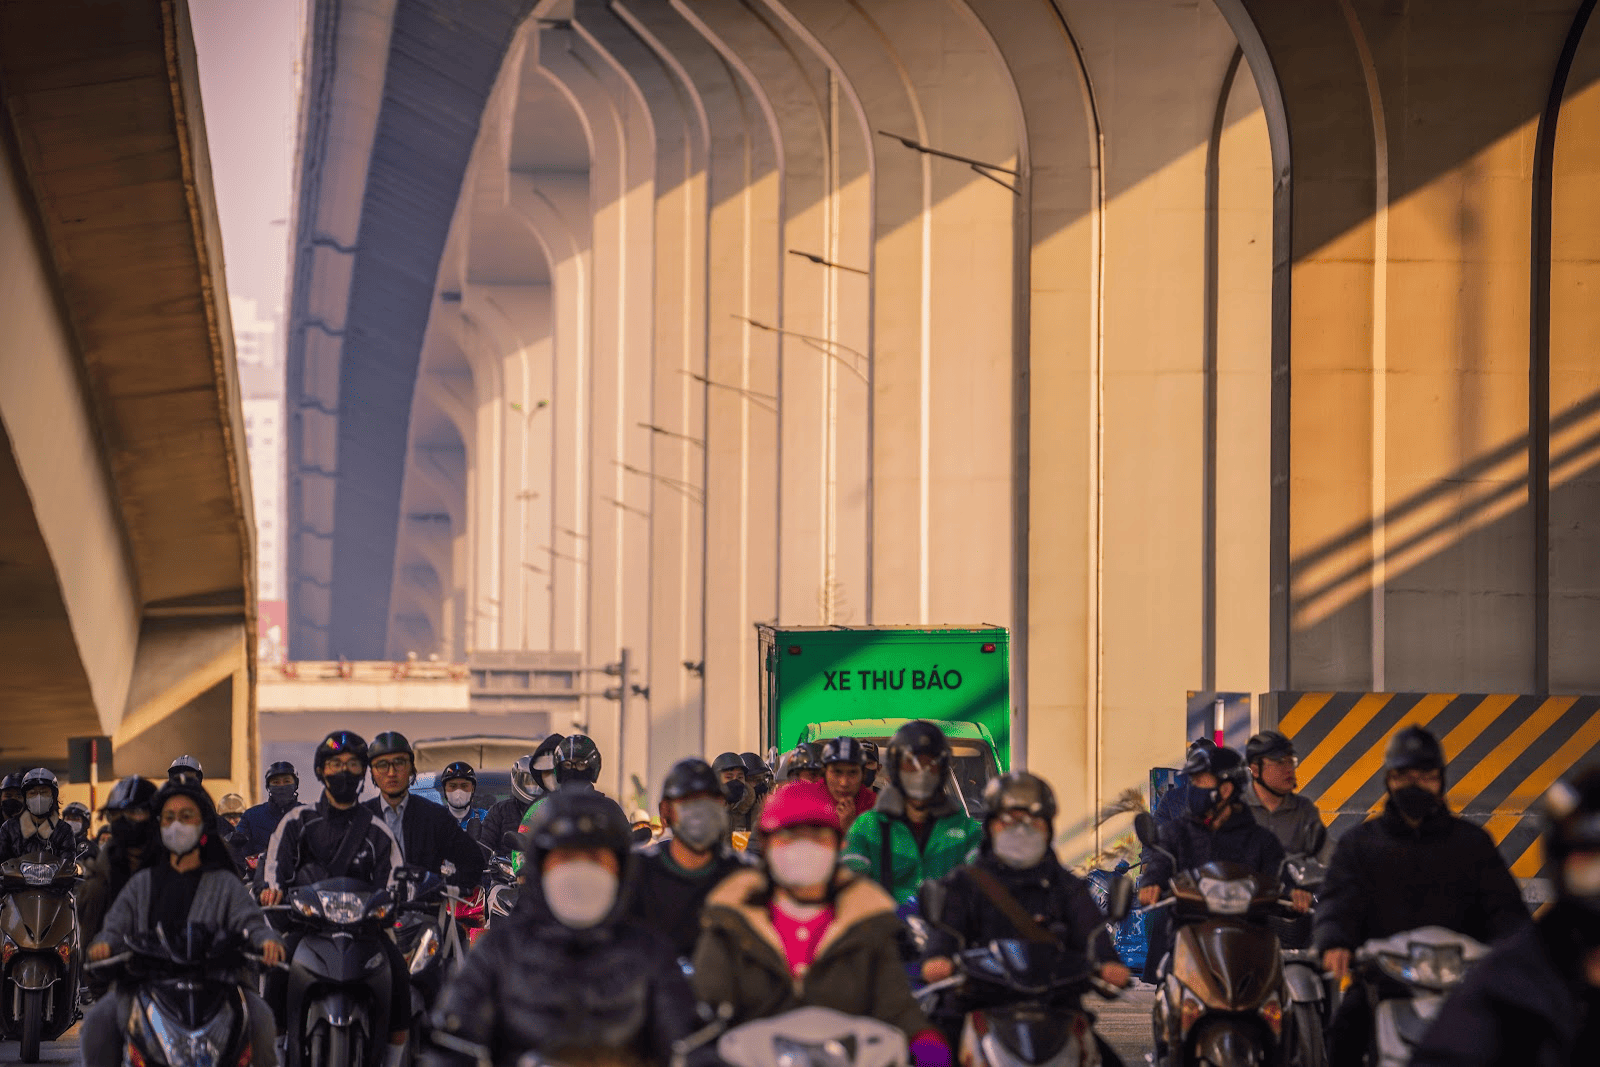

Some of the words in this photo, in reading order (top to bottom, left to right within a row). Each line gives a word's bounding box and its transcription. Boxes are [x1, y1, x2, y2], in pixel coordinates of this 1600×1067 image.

[823, 671, 850, 690] XE
[858, 668, 905, 690] THƯ
[912, 664, 962, 690] BÁO
